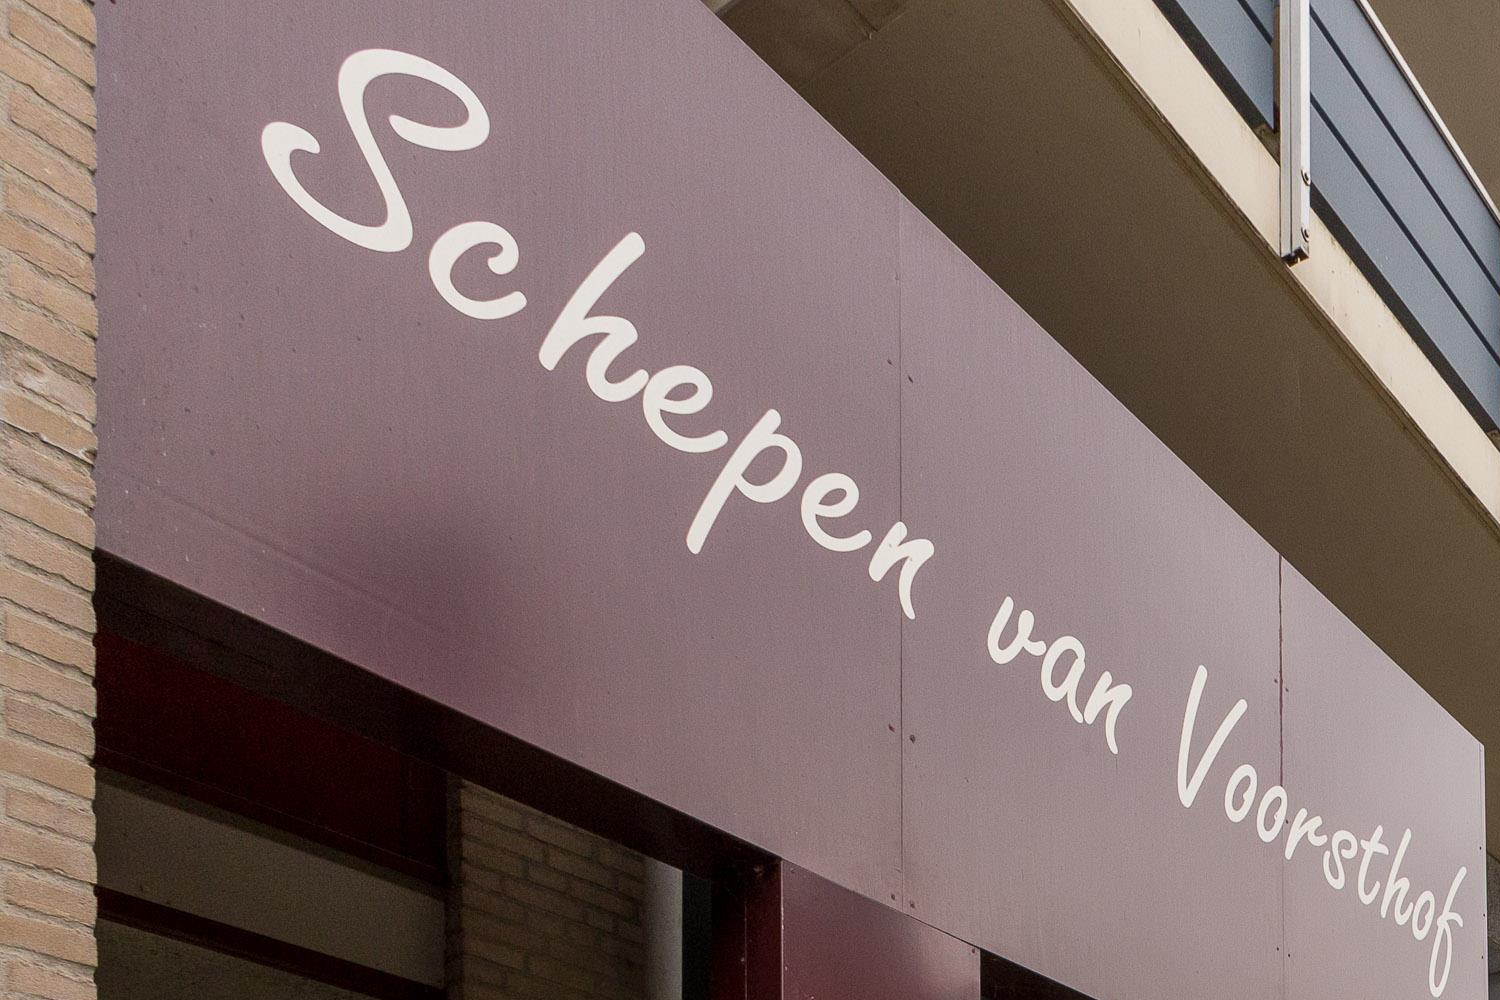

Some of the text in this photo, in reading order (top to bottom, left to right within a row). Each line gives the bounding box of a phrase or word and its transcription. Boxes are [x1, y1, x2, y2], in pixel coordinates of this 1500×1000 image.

[261, 48, 1468, 998] Schepen van Voorsthof
